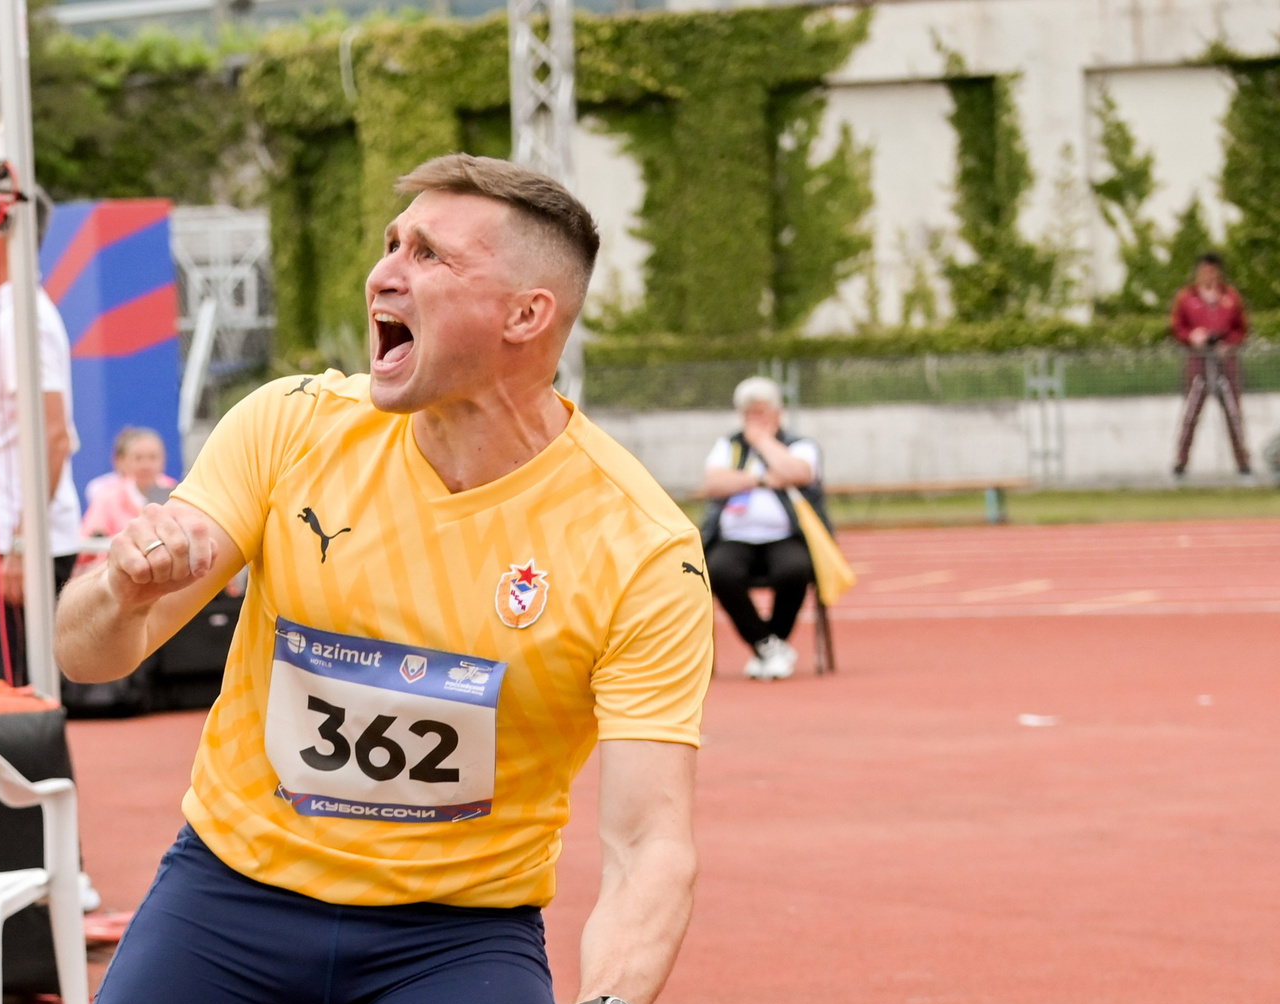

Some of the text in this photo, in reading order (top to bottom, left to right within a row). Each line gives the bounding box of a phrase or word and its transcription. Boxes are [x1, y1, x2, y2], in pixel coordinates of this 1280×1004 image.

[311, 640, 383, 668] azimut
[299, 694, 460, 783] 362
[310, 799, 436, 819] КУБОК СОЧИ
